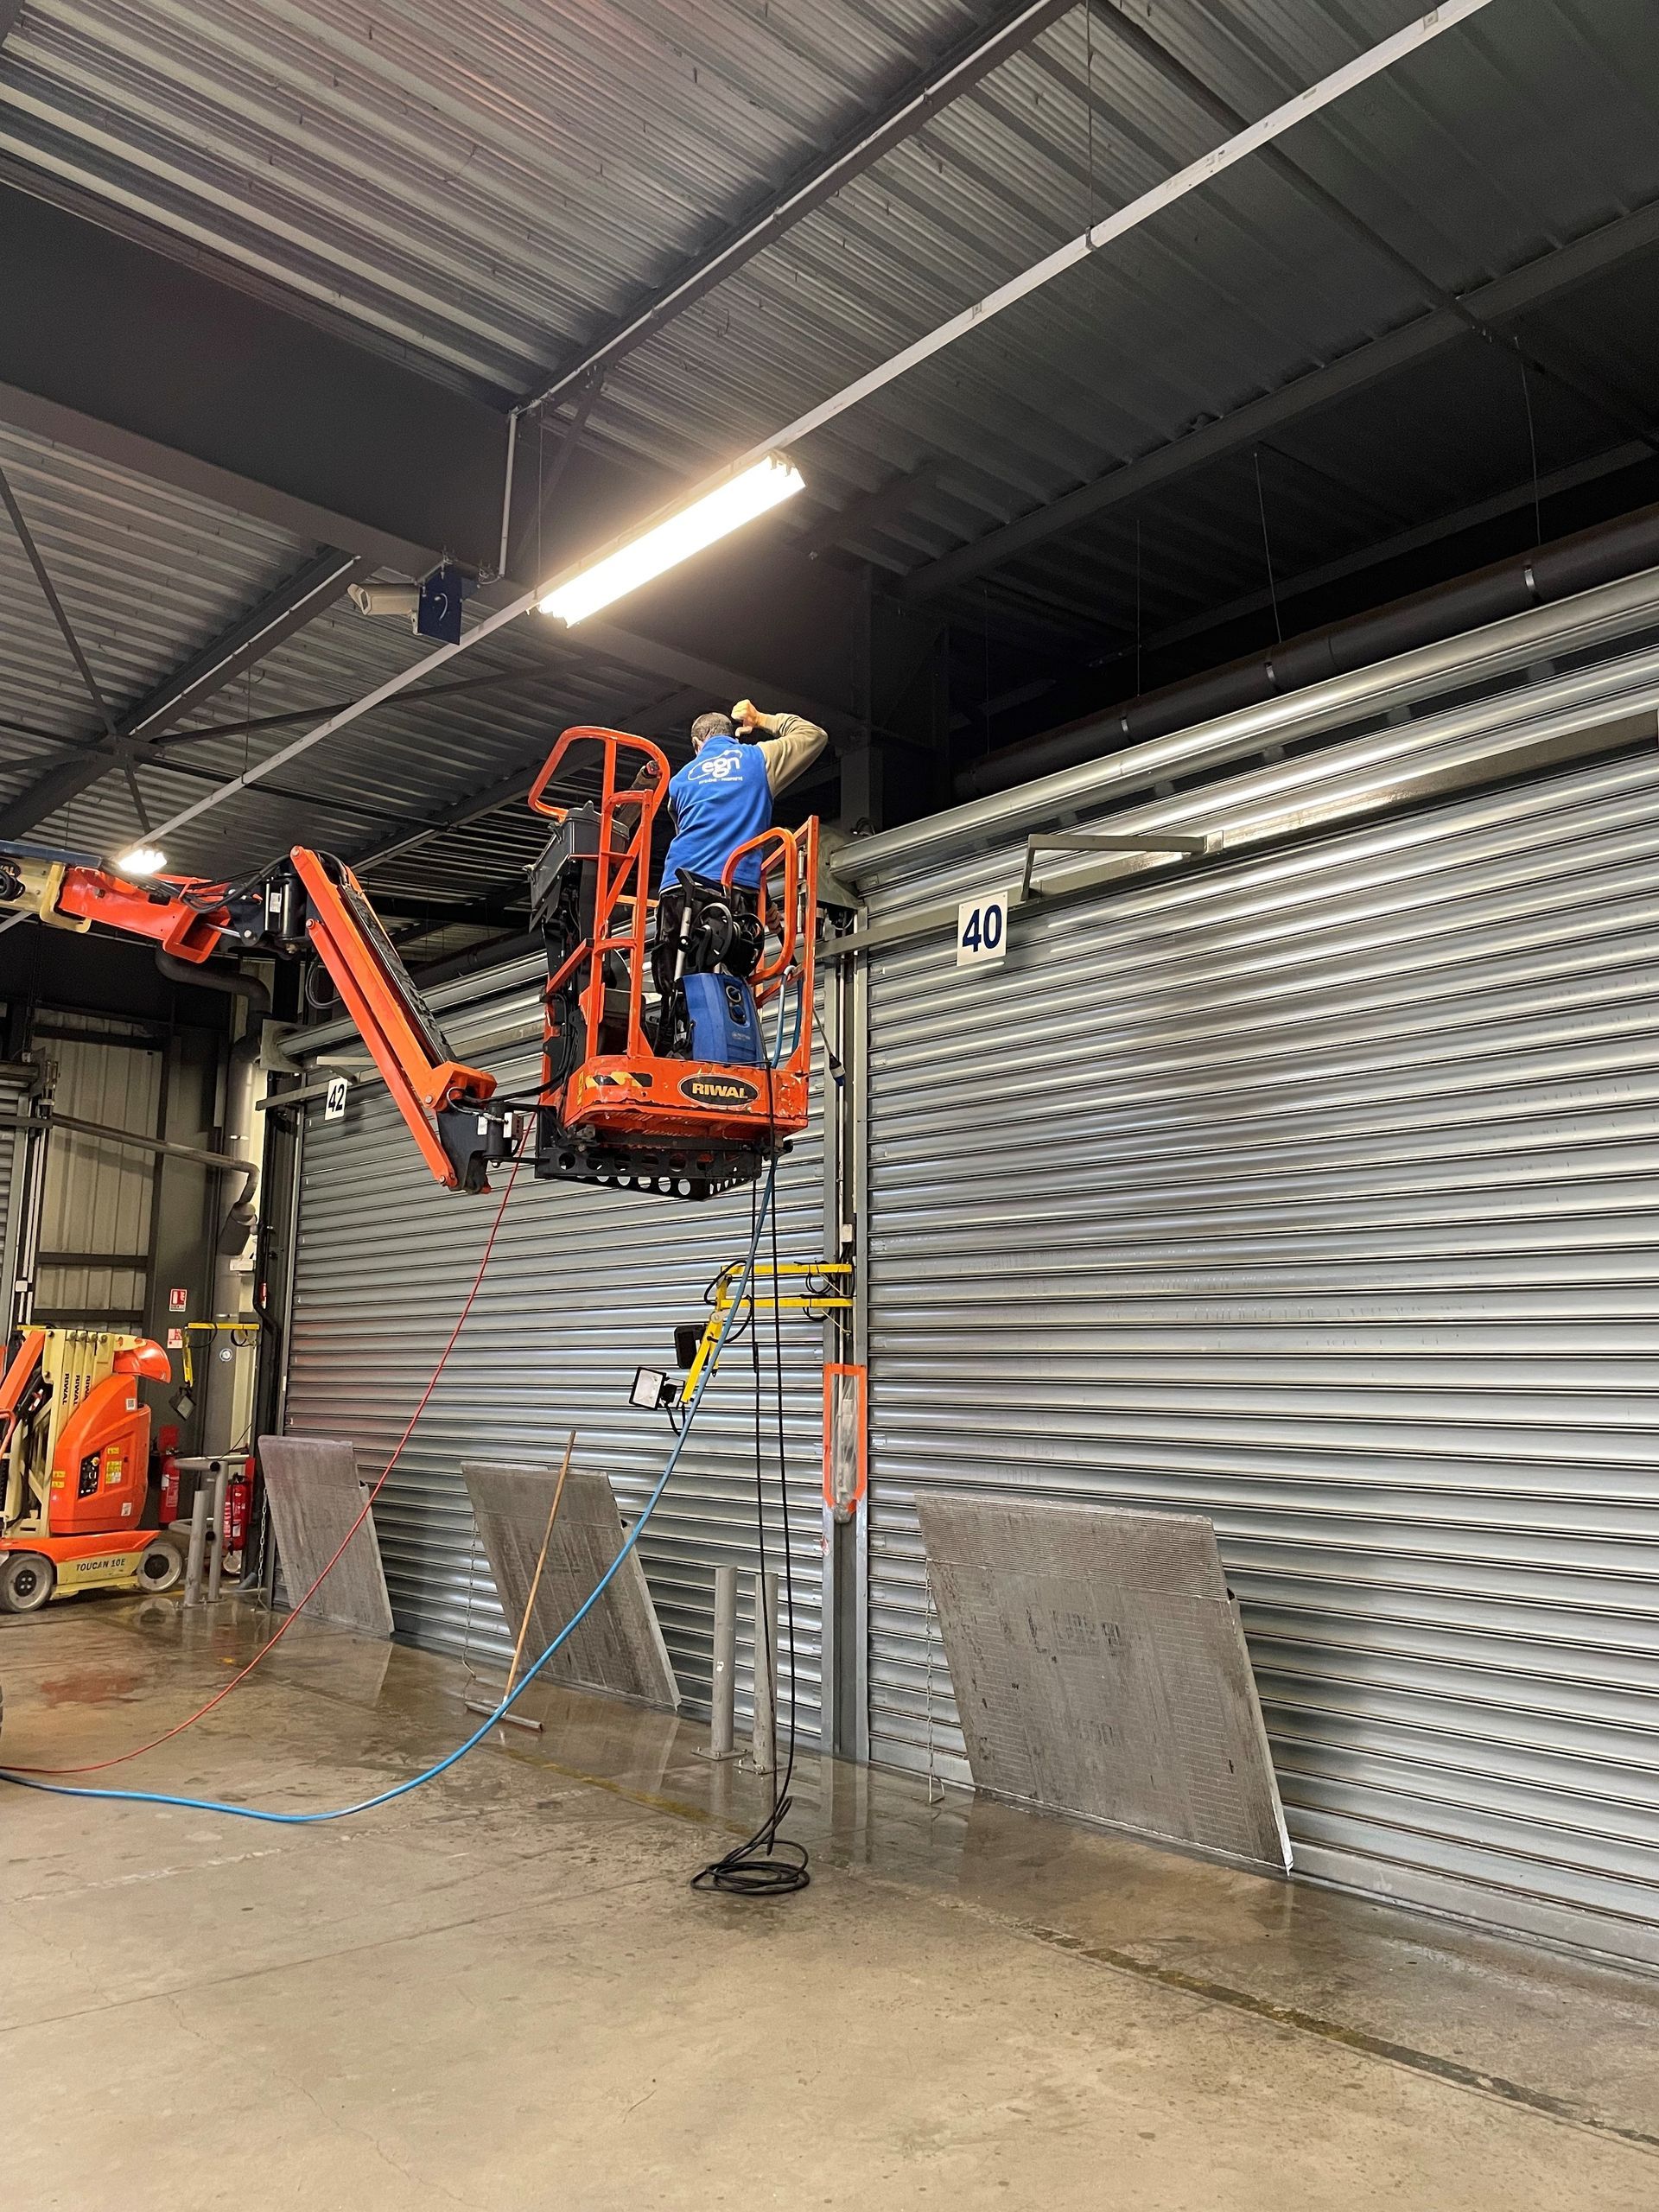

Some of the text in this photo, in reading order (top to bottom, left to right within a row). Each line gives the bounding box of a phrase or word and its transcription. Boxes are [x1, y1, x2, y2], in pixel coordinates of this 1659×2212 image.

[702, 757, 741, 778] egn
[962, 904, 1002, 952] 40
[328, 1084, 345, 1112] 42
[692, 1083, 748, 1099] RIWAL
[76, 1558, 126, 1571] TOUCAN 10E
